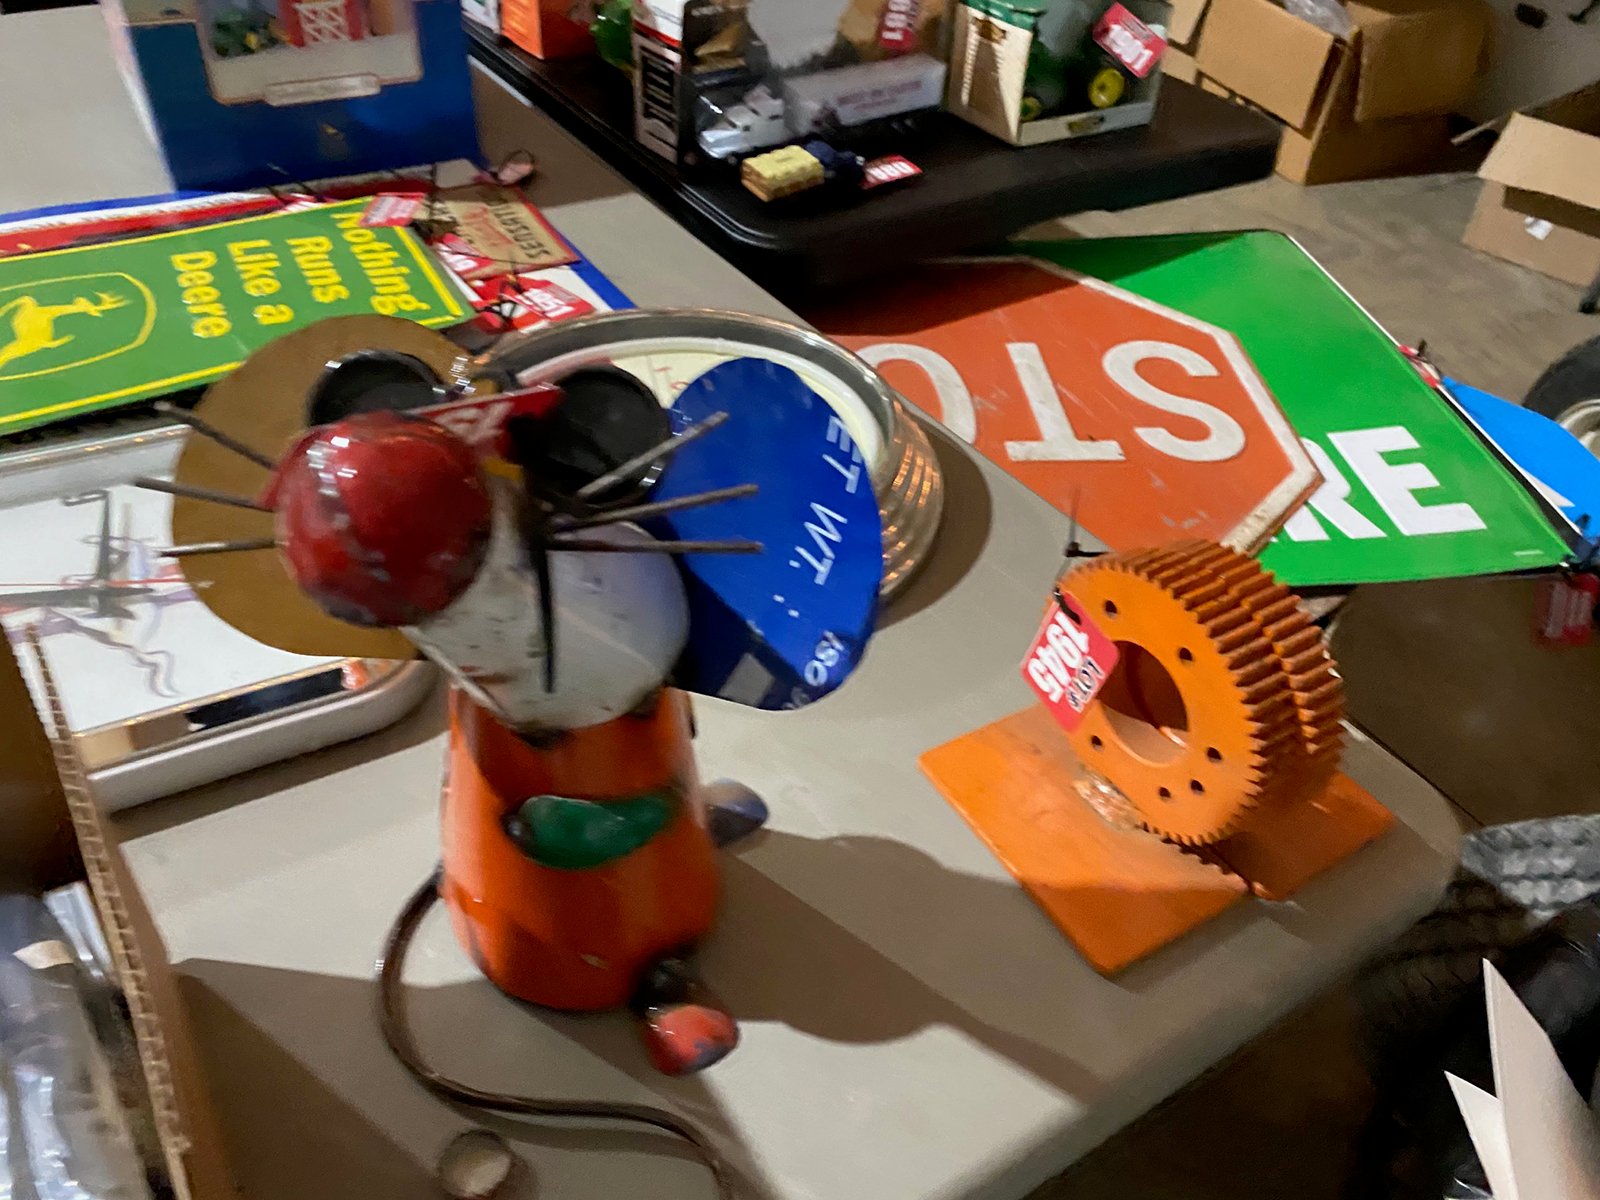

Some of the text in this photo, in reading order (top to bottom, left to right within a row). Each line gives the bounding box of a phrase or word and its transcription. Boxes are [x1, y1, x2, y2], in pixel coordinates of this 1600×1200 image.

[170, 251, 232, 338] Deere
[227, 239, 294, 325] Like a
[286, 235, 349, 303] Runs
[331, 211, 432, 315] Nothing
[1027, 610, 1089, 703] 1945
